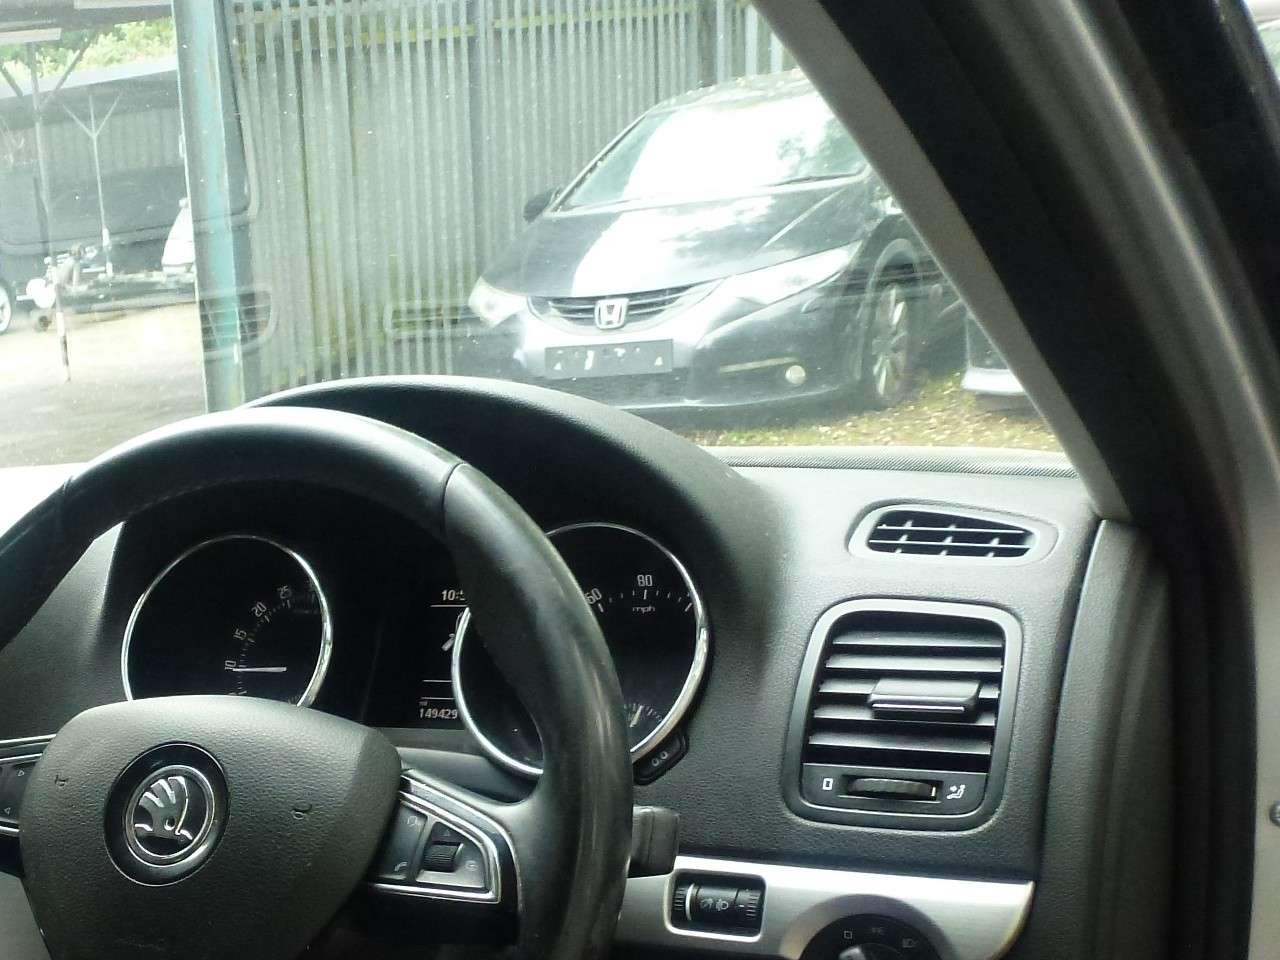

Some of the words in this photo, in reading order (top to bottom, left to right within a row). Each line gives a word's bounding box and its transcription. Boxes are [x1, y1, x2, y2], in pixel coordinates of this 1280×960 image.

[637, 574, 652, 587] 80
[251, 602, 267, 617] 20
[632, 605, 656, 614] mph
[233, 628, 247, 640] 15
[224, 660, 237, 670] 10
